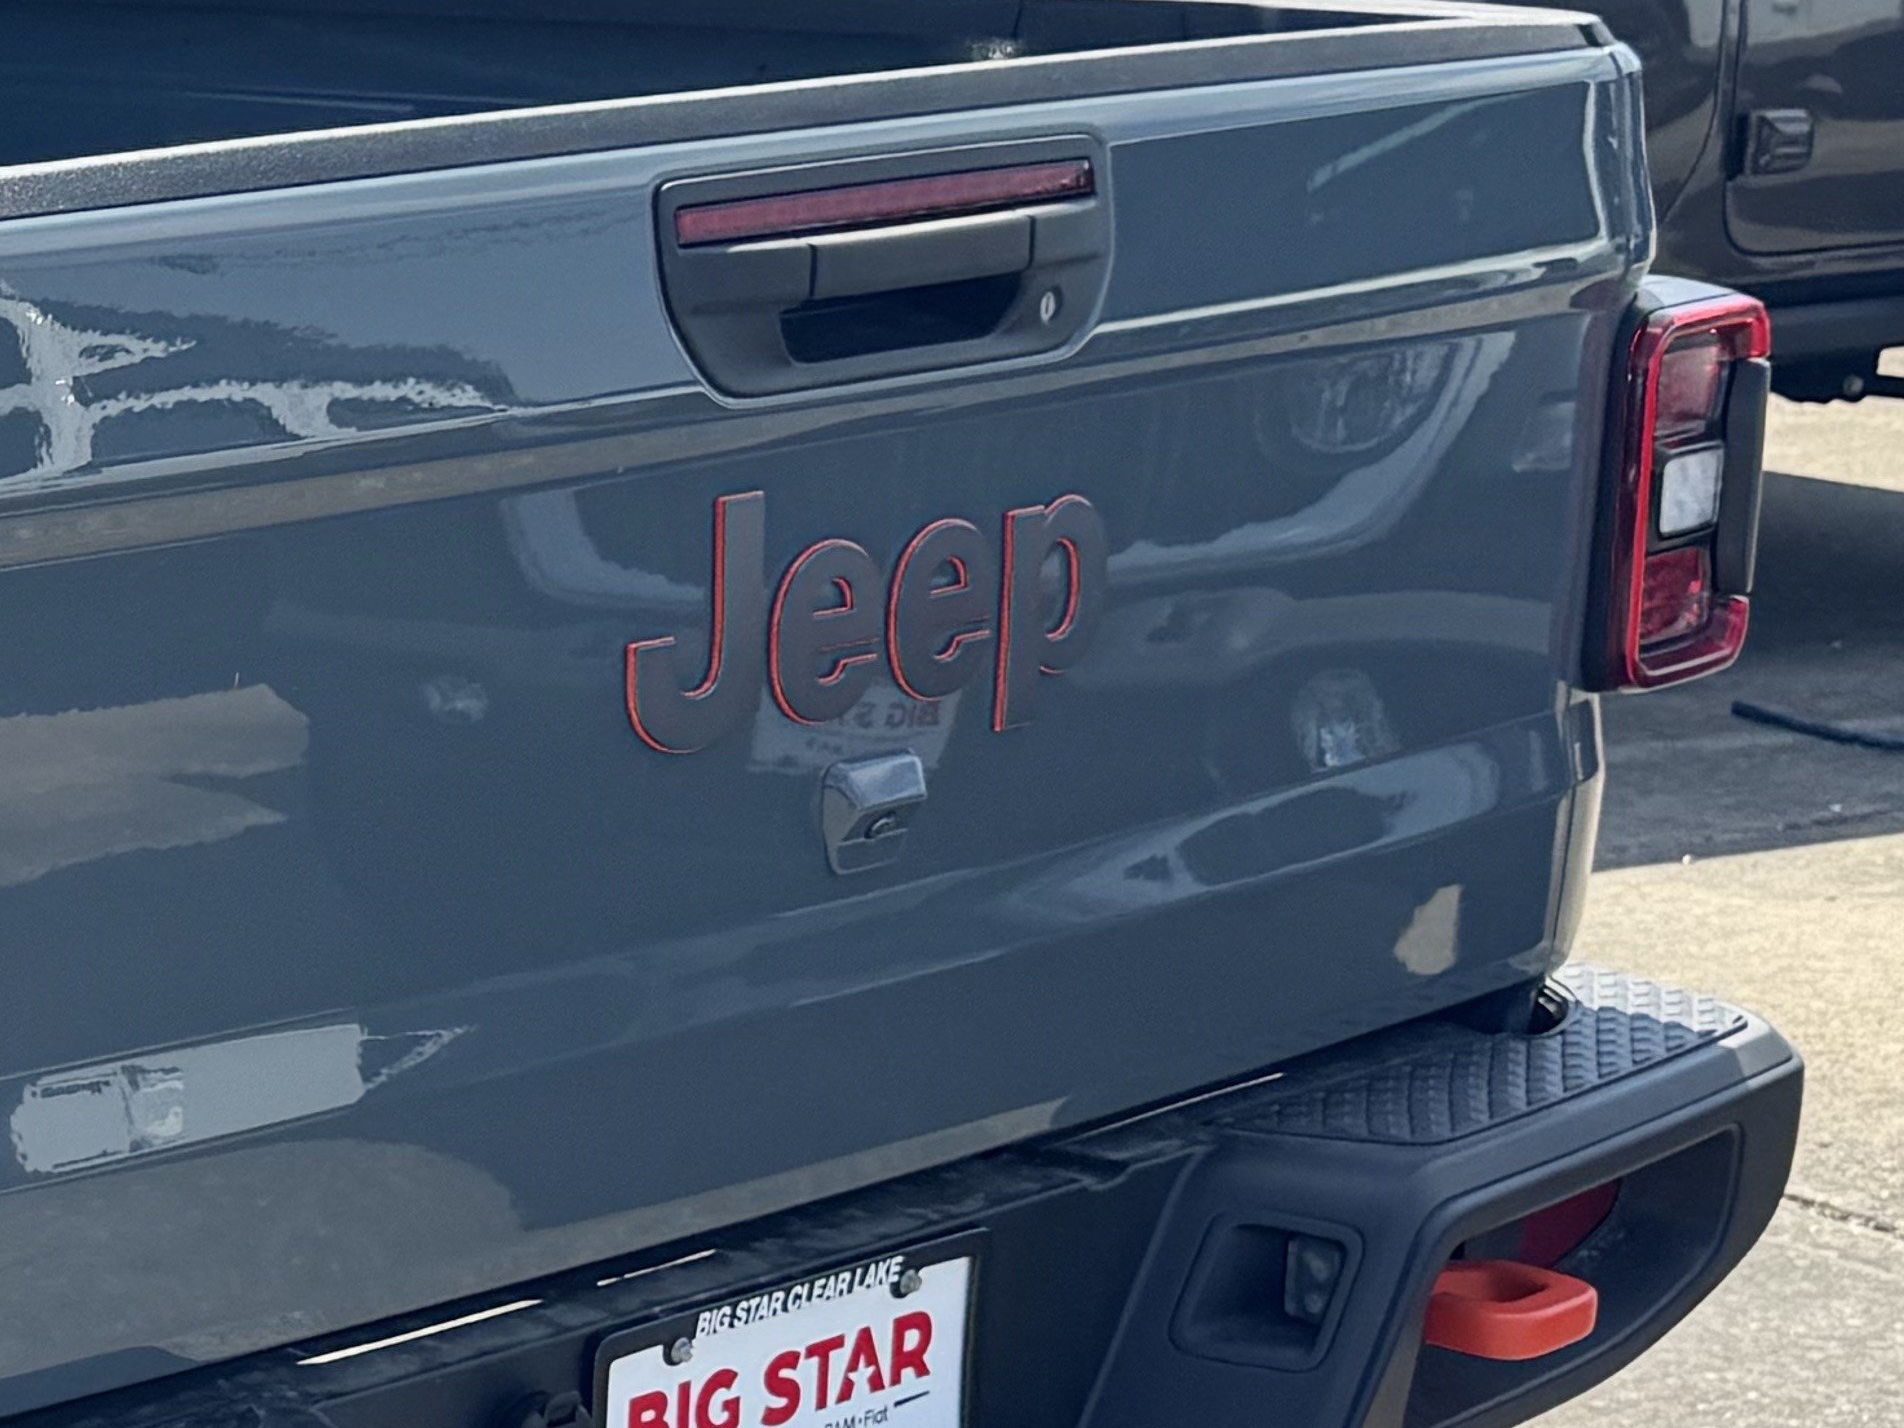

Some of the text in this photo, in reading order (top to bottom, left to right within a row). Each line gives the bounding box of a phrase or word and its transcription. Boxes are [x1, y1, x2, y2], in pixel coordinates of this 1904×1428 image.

[625, 490, 1108, 753] Jeep
[695, 1255, 906, 1338] BIG STAR CLEAR LAKE
[760, 1310, 934, 1426] STAR
[863, 1407, 889, 1426] Fiat
